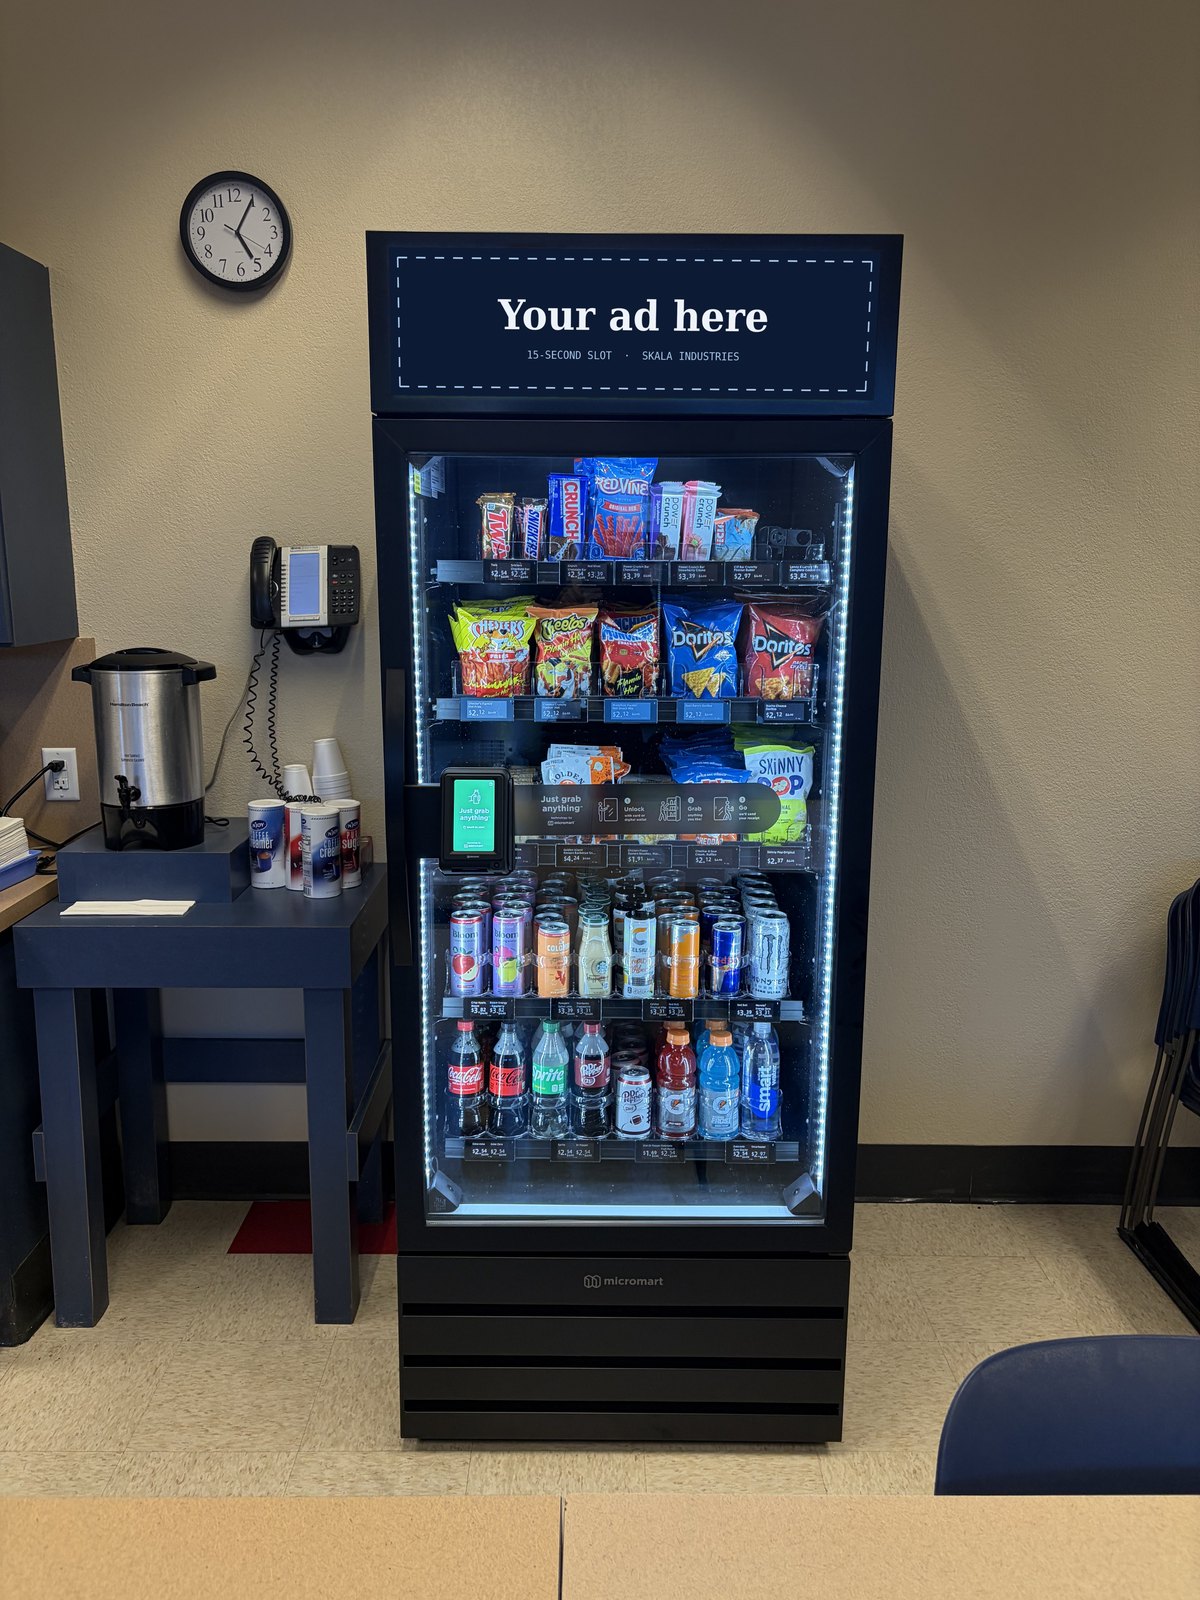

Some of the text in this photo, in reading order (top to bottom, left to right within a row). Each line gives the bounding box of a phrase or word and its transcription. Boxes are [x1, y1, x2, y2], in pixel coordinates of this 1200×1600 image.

[213, 194, 224, 208] 11
[227, 188, 242, 202] 12
[200, 208, 214, 222] 10
[262, 207, 271, 222] 2
[196, 226, 206, 241] 9
[269, 225, 278, 240] 3
[204, 244, 213, 259] 8
[264, 244, 273, 258] 4
[219, 259, 226, 273] 7
[236, 262, 246, 276] 6
[254, 258, 262, 272] 5
[497, 298, 768, 334] Your ad here
[526, 350, 740, 363] 15-SECOND SLOT SKALA INDUSTRIES
[619, 478, 649, 496] VINE
[563, 481, 580, 544] CRUNCH
[663, 497, 671, 528] crunch
[696, 497, 704, 528] crunch
[526, 508, 540, 560] SNICKERS
[541, 613, 588, 642] Cheetos
[672, 630, 732, 648] Doritos
[754, 635, 812, 656] Doritos
[562, 795, 581, 804] grab
[542, 805, 580, 813] anything
[320, 847, 336, 858] crea
[452, 930, 478, 938] Bloom
[494, 930, 518, 938] Bloom
[752, 976, 786, 988] MONSTER
[448, 1066, 482, 1084] Coca-Cola
[491, 1067, 524, 1084] Coca-Cola
[532, 1064, 564, 1084] Sprite
[758, 1066, 772, 1112] smart
[604, 1276, 664, 1286] micromart
